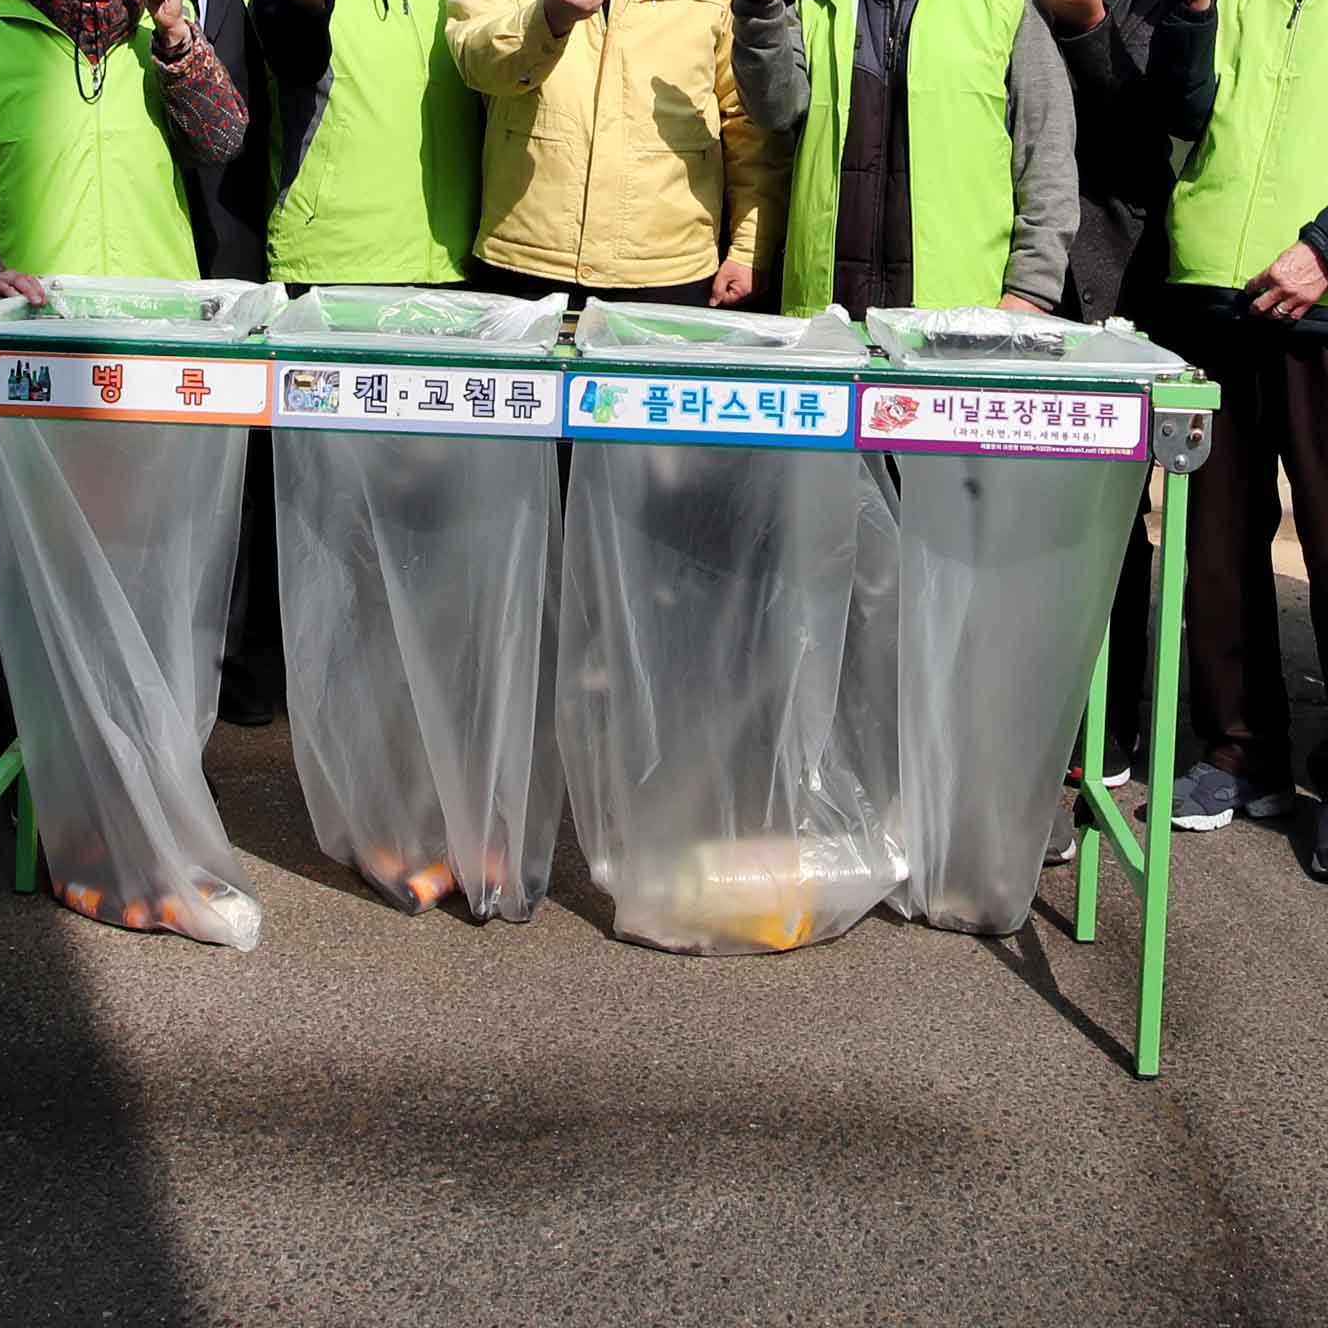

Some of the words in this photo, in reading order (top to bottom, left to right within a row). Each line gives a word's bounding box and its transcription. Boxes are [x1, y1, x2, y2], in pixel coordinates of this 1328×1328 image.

[92, 363, 123, 404] 병
[175, 368, 211, 406] 류
[642, 383, 825, 429] 플라스틱류
[932, 395, 1120, 429] 비닐포장필름류
